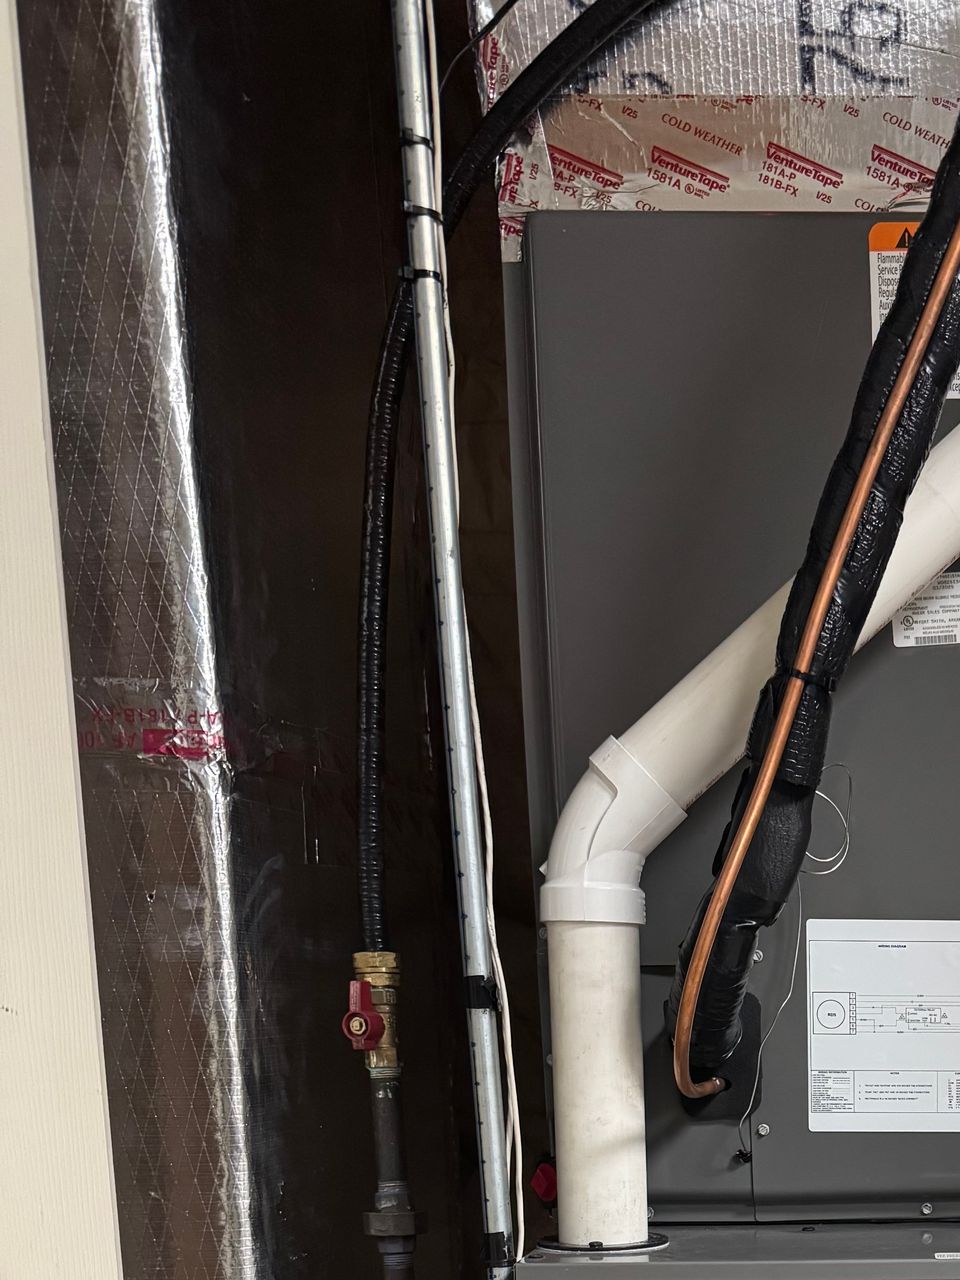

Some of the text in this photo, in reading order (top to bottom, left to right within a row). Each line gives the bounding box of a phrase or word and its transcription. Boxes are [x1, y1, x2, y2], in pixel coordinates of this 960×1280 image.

[661, 112, 744, 157] COLD WEATHER
[882, 111, 950, 150] COLD WEATH
[646, 167, 682, 191] 1581A
[650, 150, 730, 193] VentureTape
[761, 161, 797, 182] 181A-P
[766, 148, 843, 189] VentureTape
[865, 166, 900, 189] 1581A
[870, 149, 935, 186] VentureTap
[757, 173, 799, 198] 181B-FX
[877, 264, 898, 275] Service
